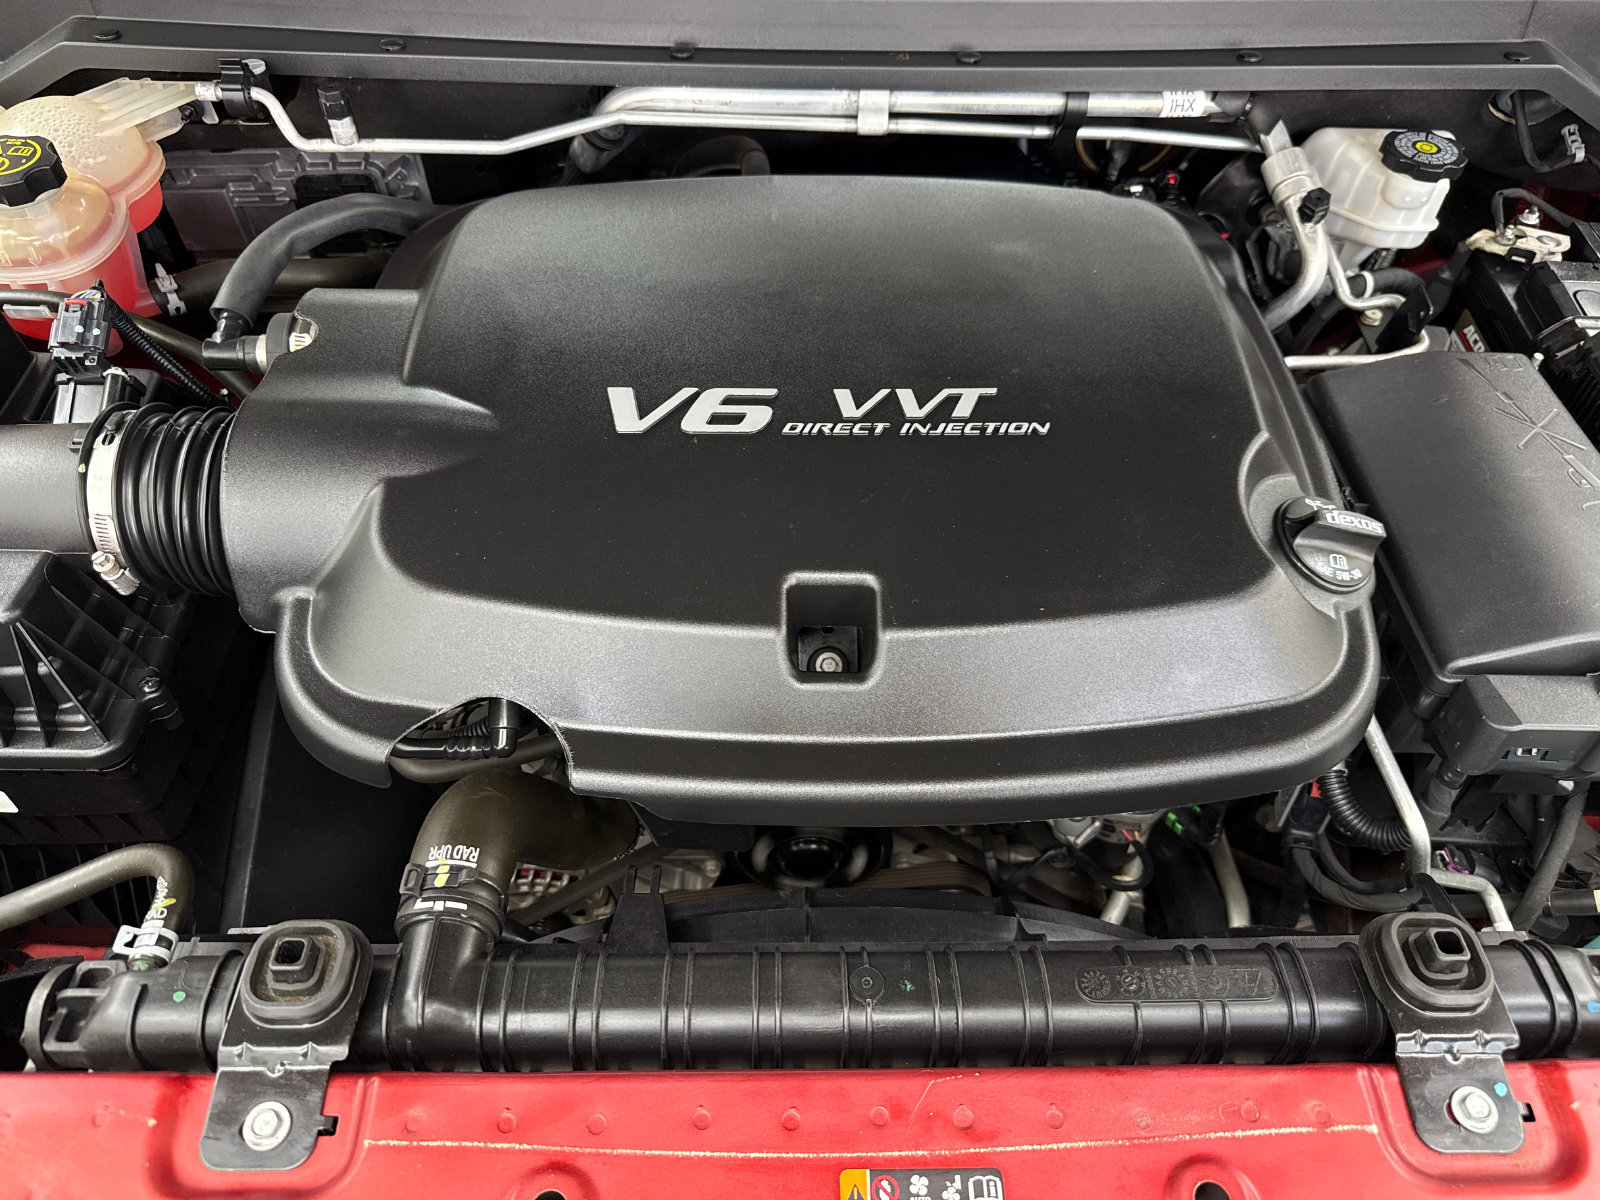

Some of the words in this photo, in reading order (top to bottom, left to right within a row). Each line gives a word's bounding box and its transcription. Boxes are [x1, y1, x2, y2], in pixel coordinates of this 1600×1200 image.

[1170, 99, 1195, 113] IHX
[607, 386, 779, 435] V6
[833, 387, 999, 420] VVT
[781, 421, 892, 436] DIRECT
[899, 421, 1051, 436] INJECTION
[1325, 510, 1383, 533] dexos
[1316, 562, 1334, 577] SAE
[428, 844, 452, 860] UPR
[453, 845, 480, 862] RAD
